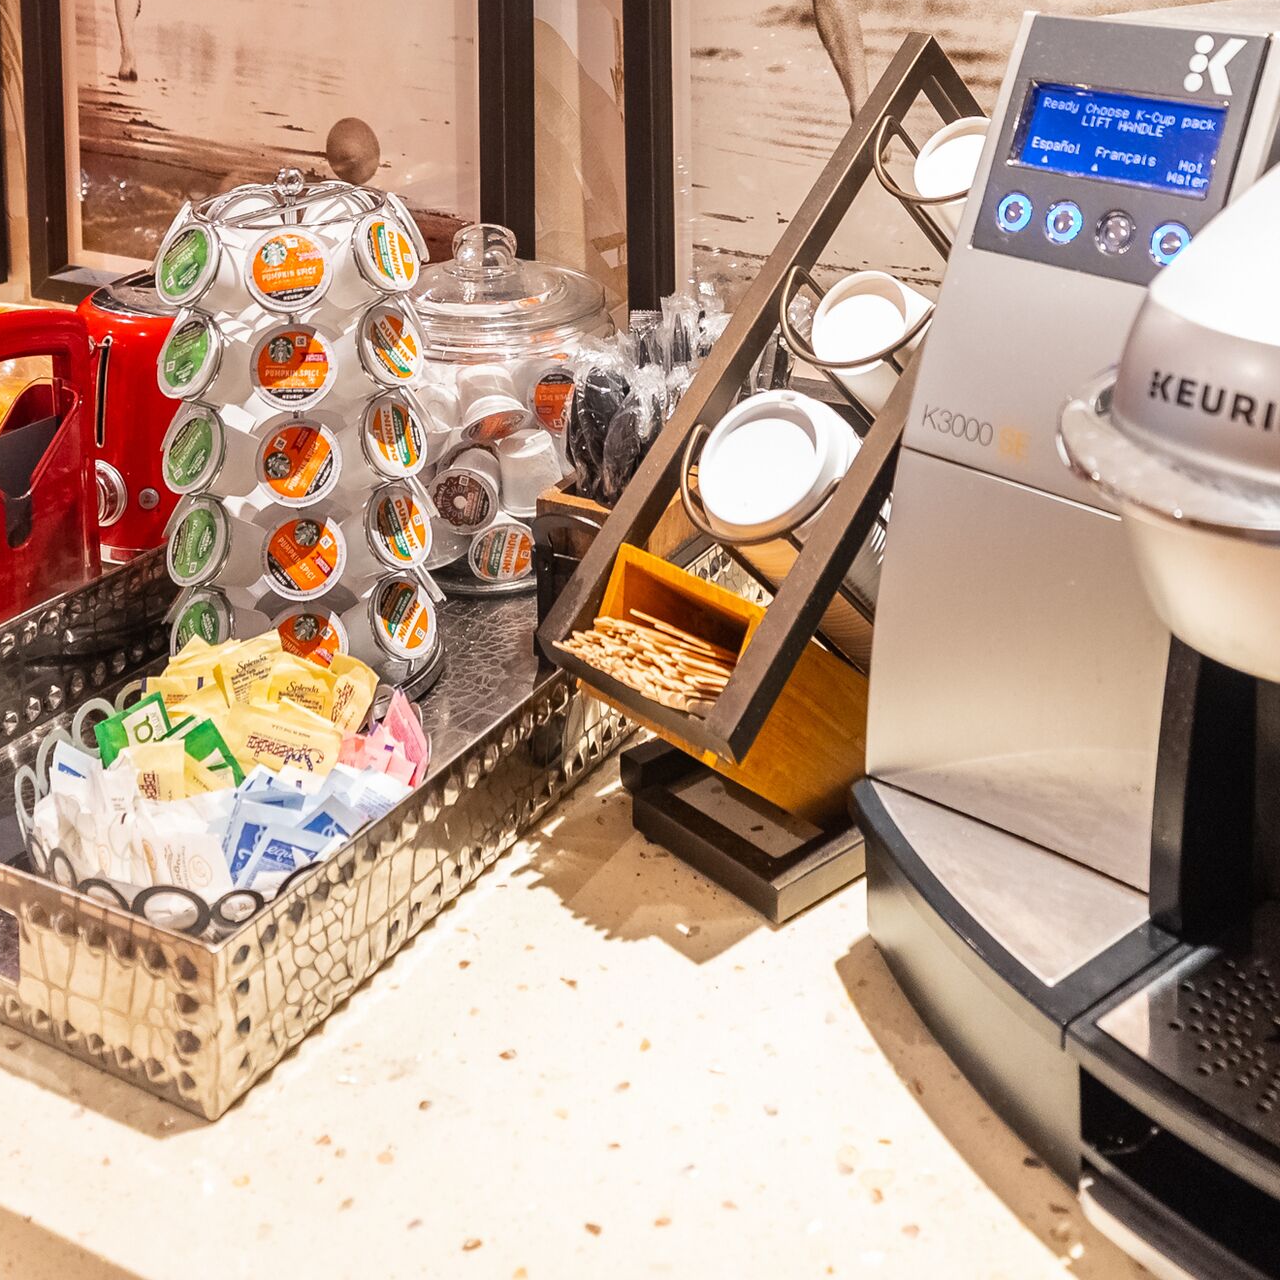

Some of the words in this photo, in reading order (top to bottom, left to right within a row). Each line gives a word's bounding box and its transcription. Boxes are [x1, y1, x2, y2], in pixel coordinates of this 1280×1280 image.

[1043, 97, 1080, 115] Ready
[1086, 103, 1130, 119] Choose
[1136, 110, 1176, 126] K-Cup
[1182, 116, 1217, 132] pack
[1081, 116, 1113, 130] LIFT
[1117, 121, 1165, 138] HANDLE
[1031, 136, 1081, 156] Español
[1095, 146, 1157, 168] Français
[1178, 160, 1204, 174] Hot
[262, 270, 295, 282] PUMPKIN
[265, 369, 298, 377] PUMPKIN
[922, 404, 994, 447] K3000
[277, 537, 302, 564] PUMPKIN
[502, 533, 518, 573] DUNKIN'
[286, 681, 319, 694] Splenda
[246, 735, 325, 772] Splenda
